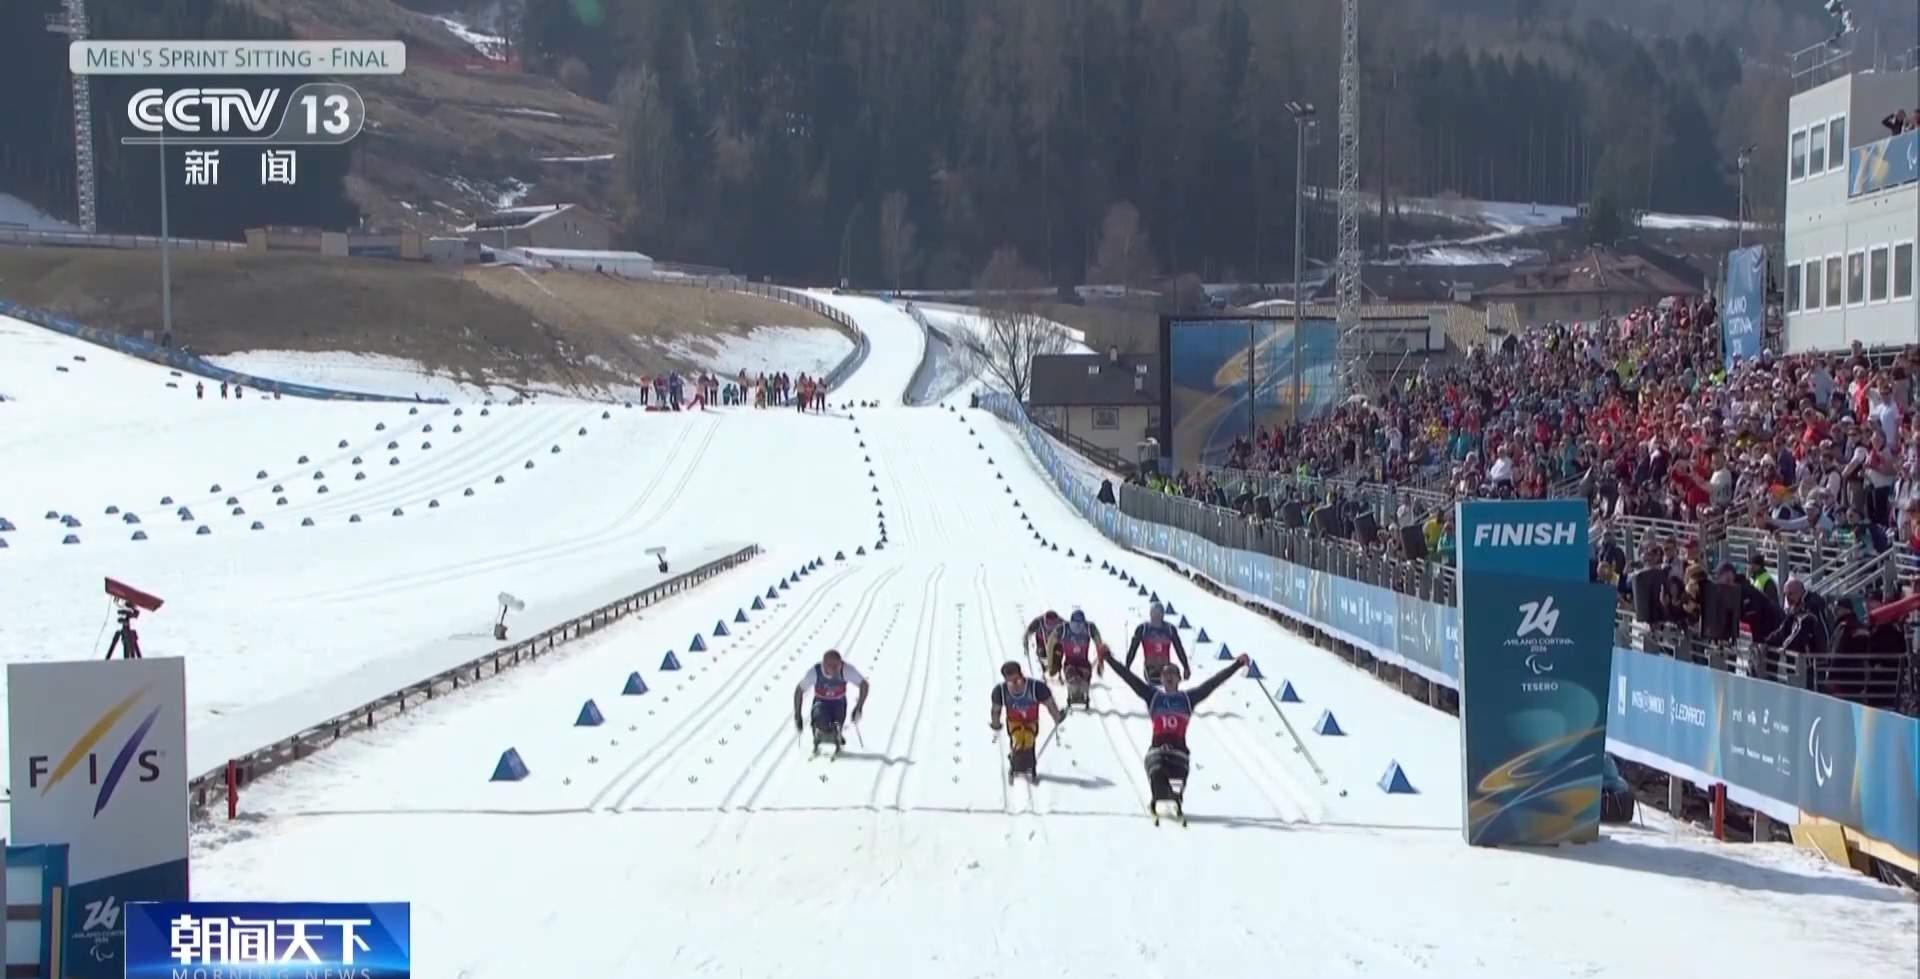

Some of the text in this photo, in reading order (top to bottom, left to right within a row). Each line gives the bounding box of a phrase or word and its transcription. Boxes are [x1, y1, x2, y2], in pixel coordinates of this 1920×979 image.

[1474, 522, 1577, 547] FINISH
[1521, 682, 1559, 692] TESERO
[1161, 714, 1178, 730] 10
[29, 749, 161, 788] FIS
